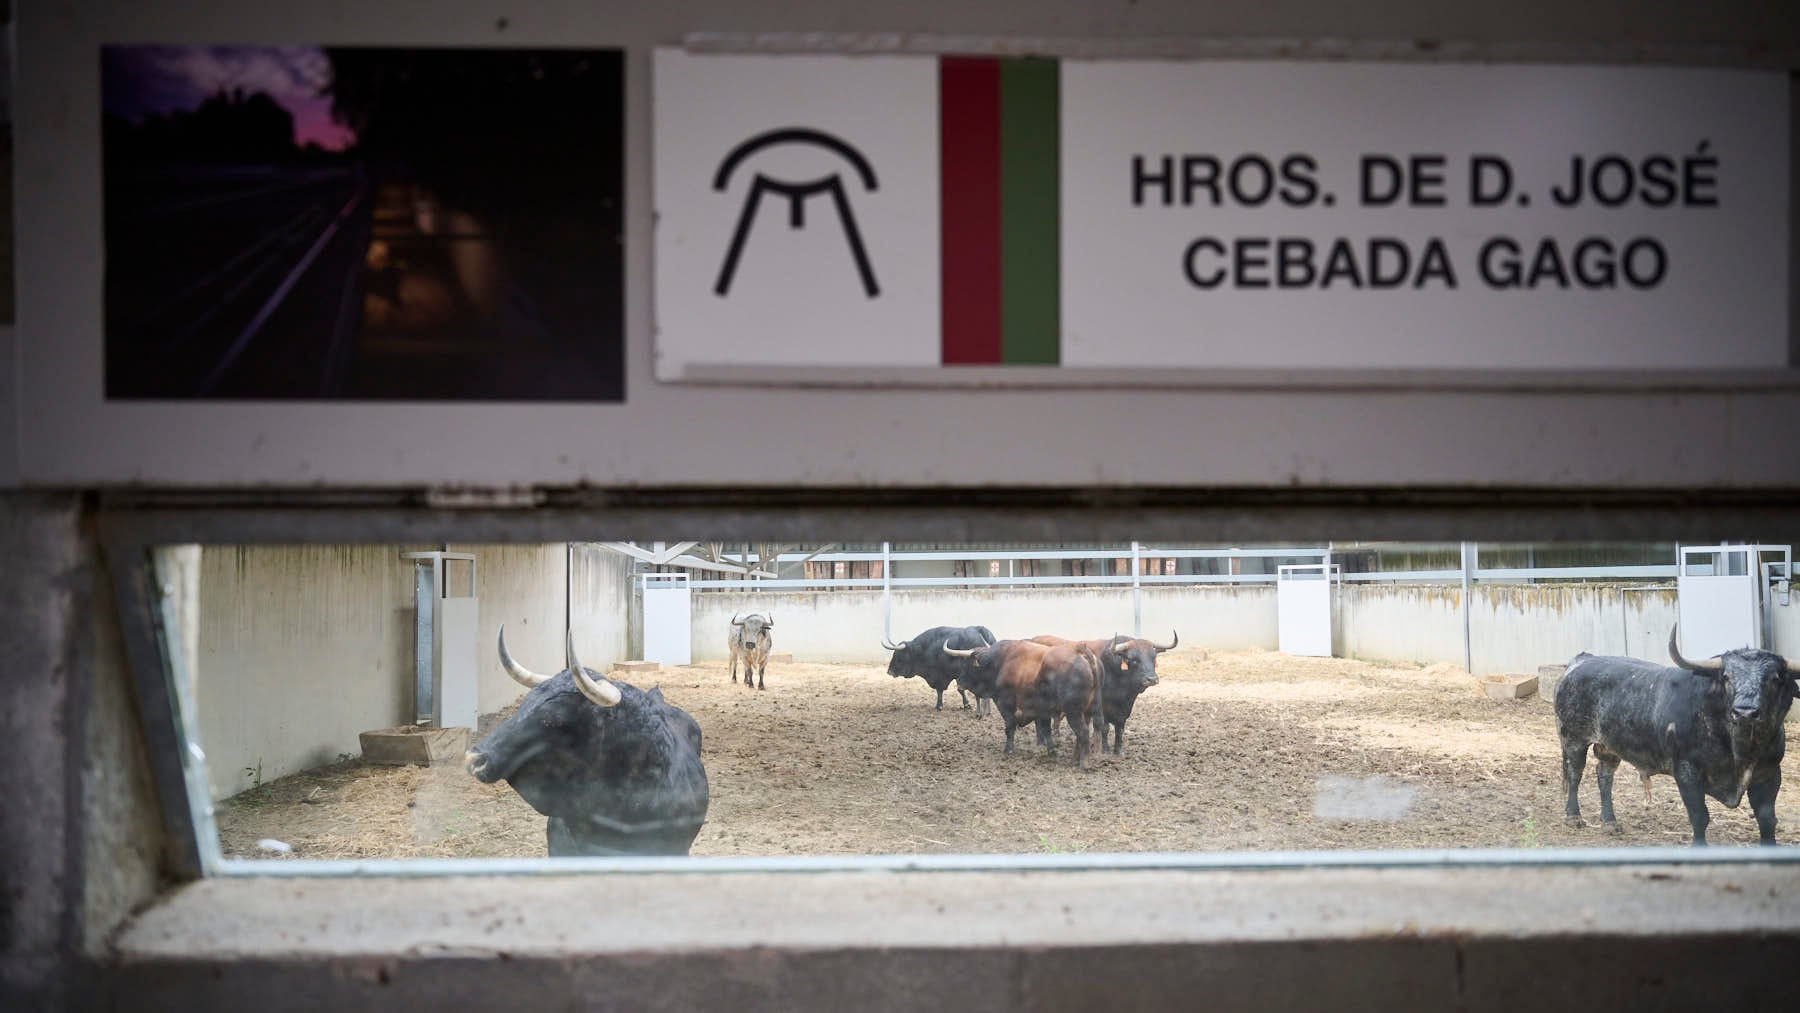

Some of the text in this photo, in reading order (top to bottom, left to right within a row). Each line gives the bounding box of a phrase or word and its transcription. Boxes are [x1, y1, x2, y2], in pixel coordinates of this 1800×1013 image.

[1132, 140, 1719, 209] HROS. DE D. JOSÉ
[1183, 236, 1668, 290] CEBADA GAGO
